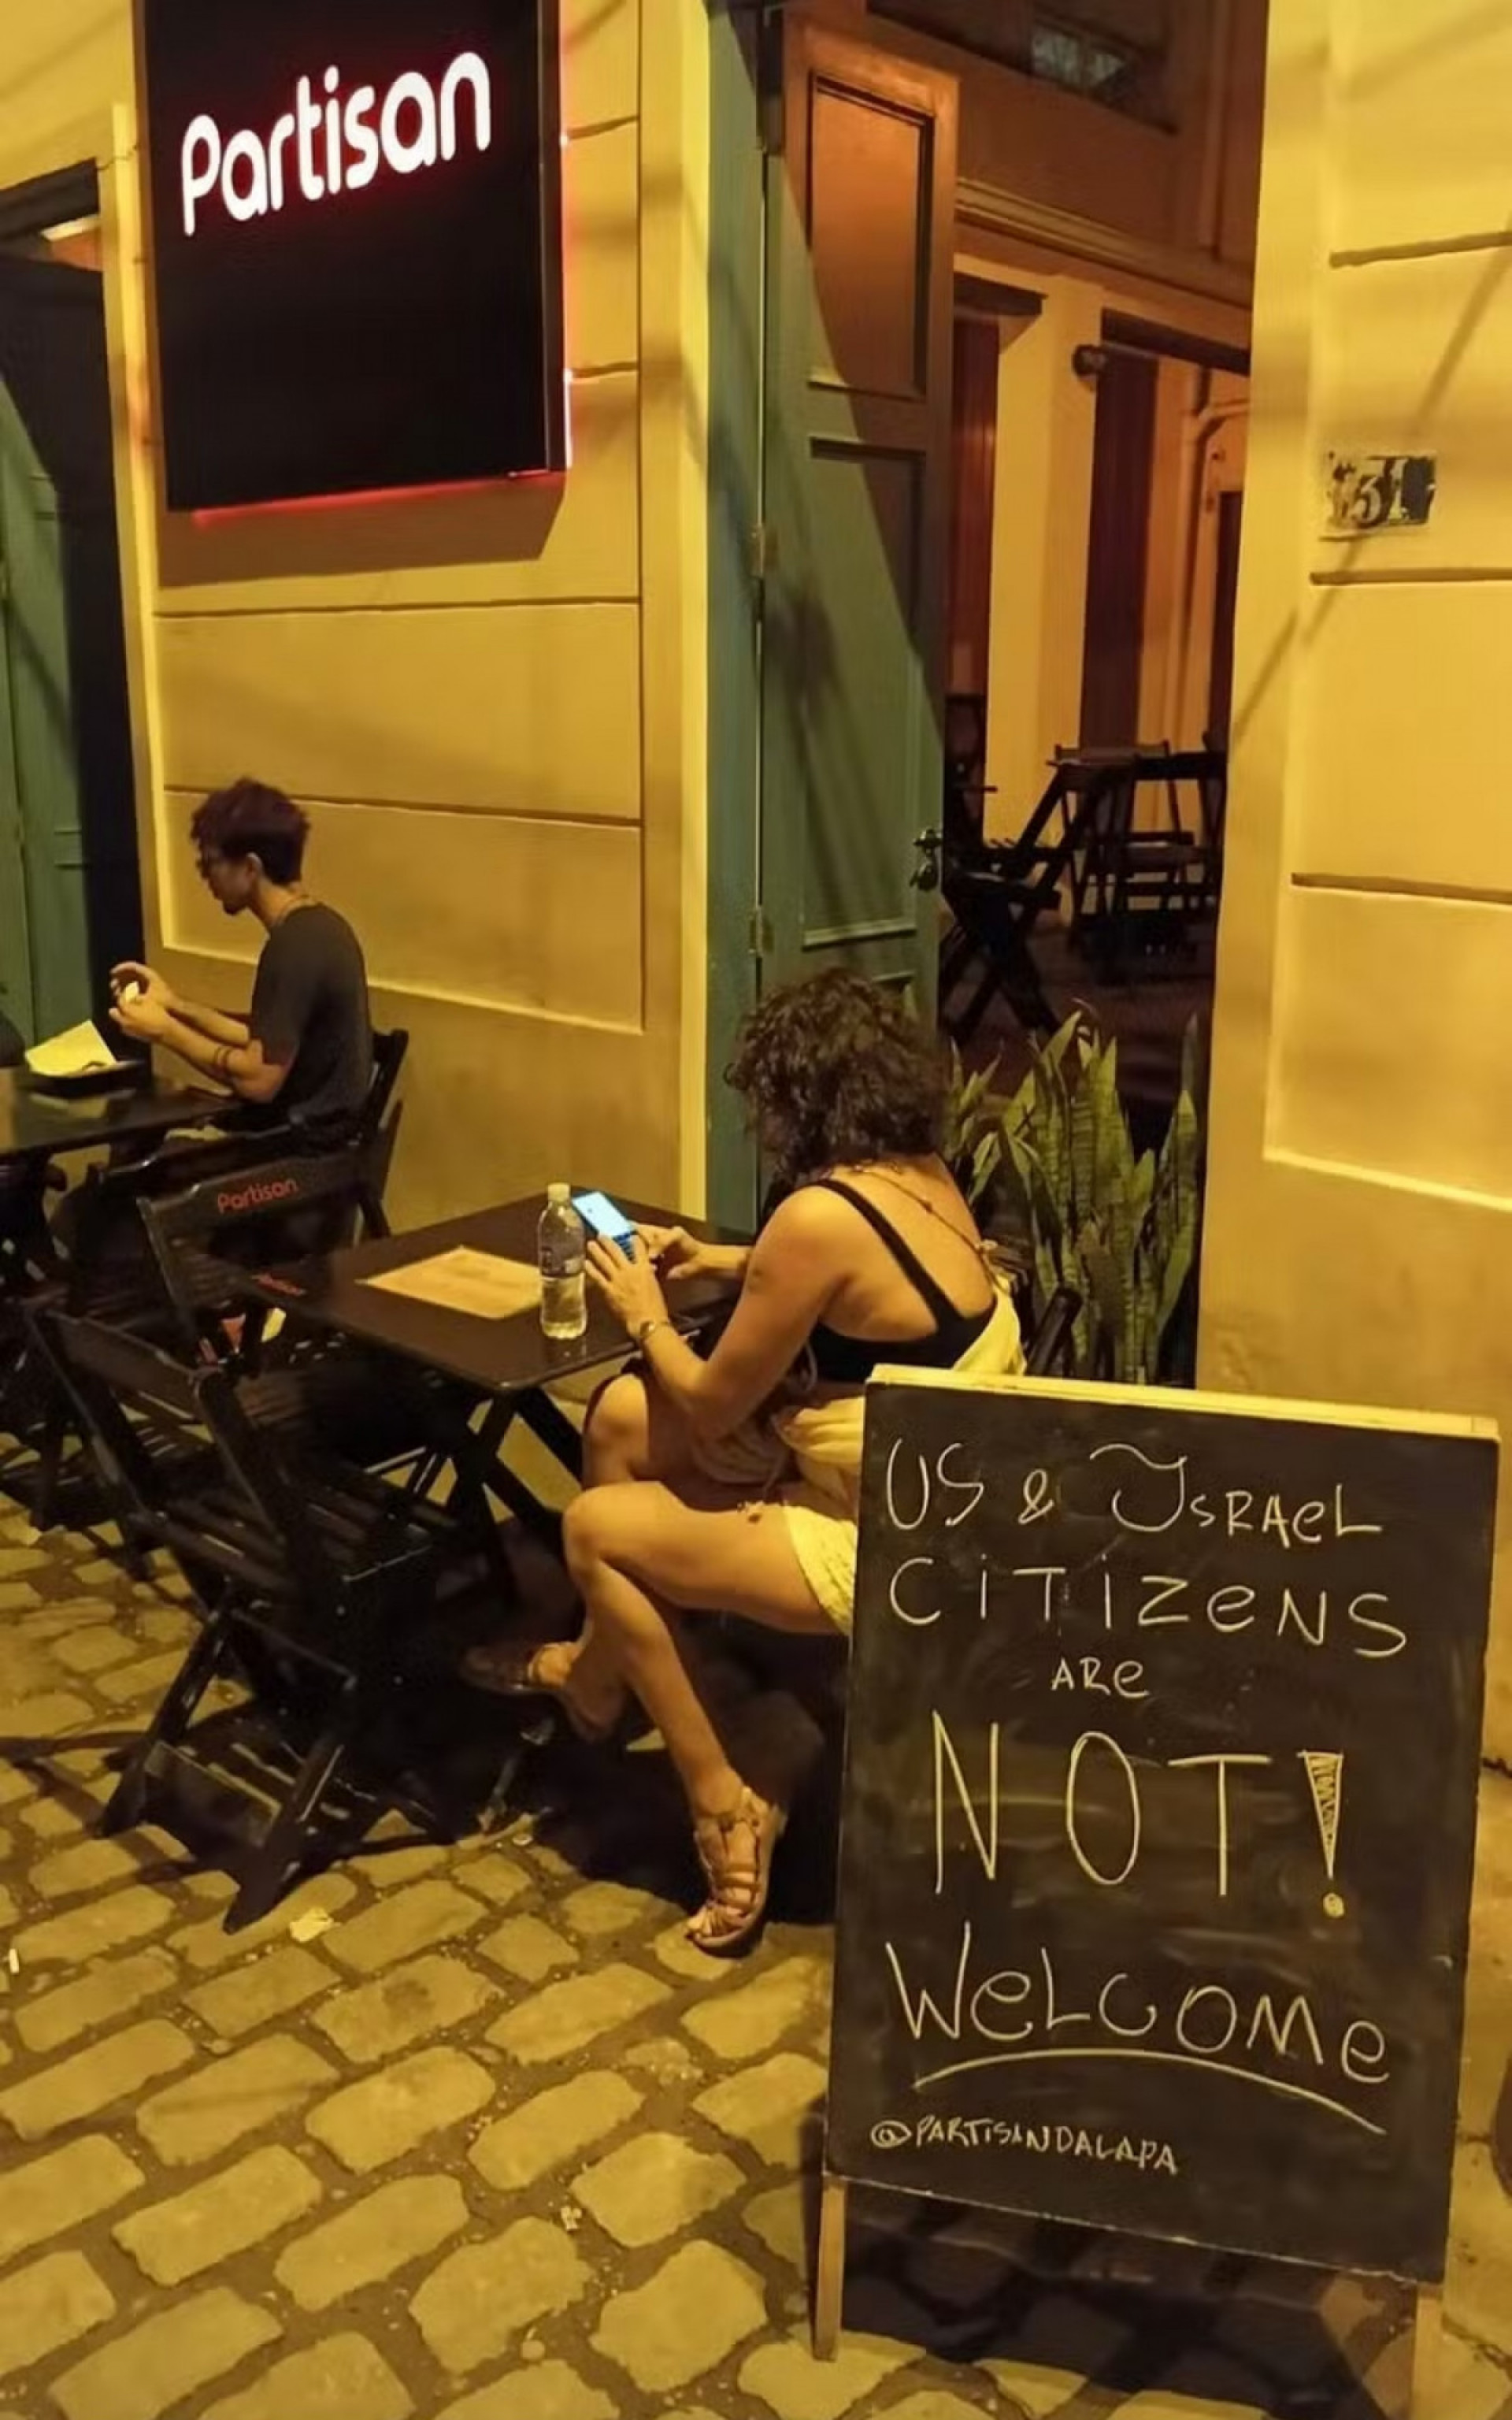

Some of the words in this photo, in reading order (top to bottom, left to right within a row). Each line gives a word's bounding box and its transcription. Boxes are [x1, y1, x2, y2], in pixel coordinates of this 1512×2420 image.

[181, 51, 491, 237] Partisan
[217, 1178, 298, 1214] Partisan
[887, 1438, 984, 1530] US
[1018, 1469, 1054, 1523] &
[932, 1710, 1343, 1918] NOT!
